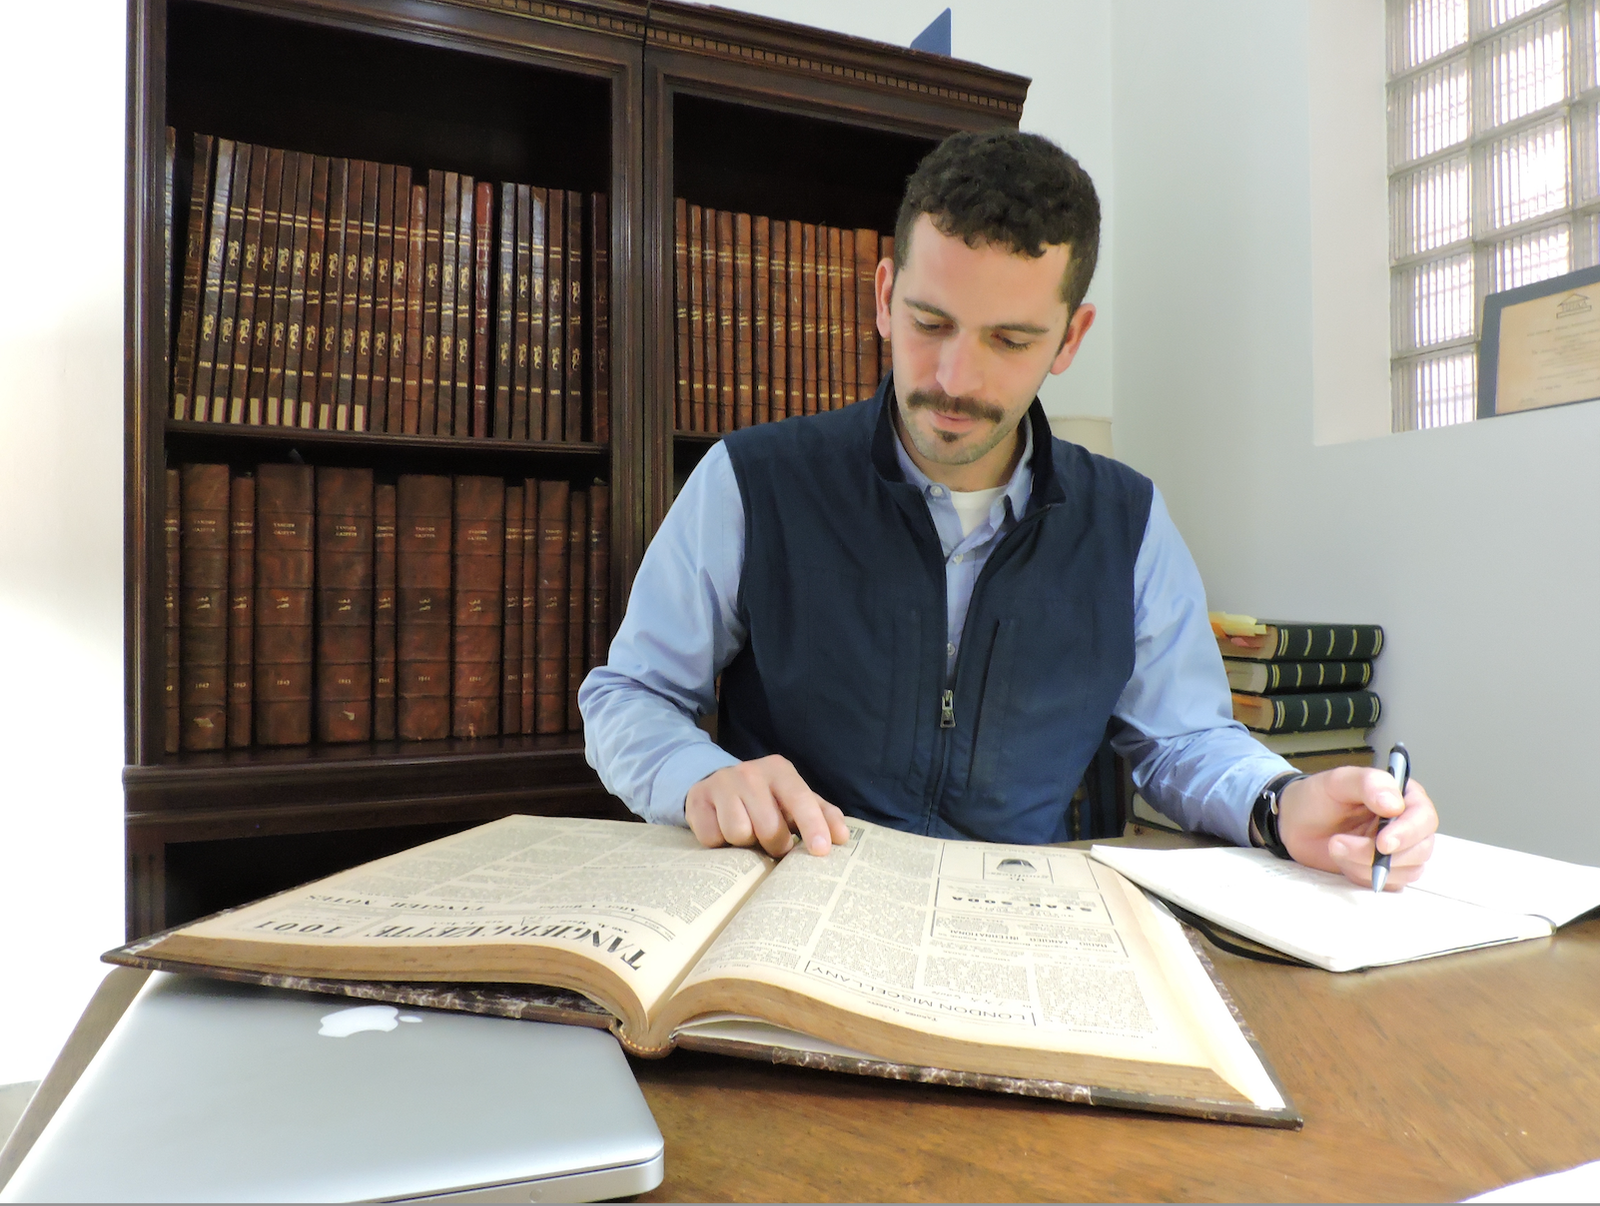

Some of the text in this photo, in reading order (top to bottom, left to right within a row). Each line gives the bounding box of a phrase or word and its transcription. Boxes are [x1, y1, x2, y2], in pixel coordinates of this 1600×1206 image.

[254, 920, 344, 935] 1001
[364, 925, 513, 940] GAZETTE
[510, 925, 645, 971] TANGIER
[812, 966, 934, 1009] MISCELLANY
[938, 1003, 1027, 1021] LONDON
